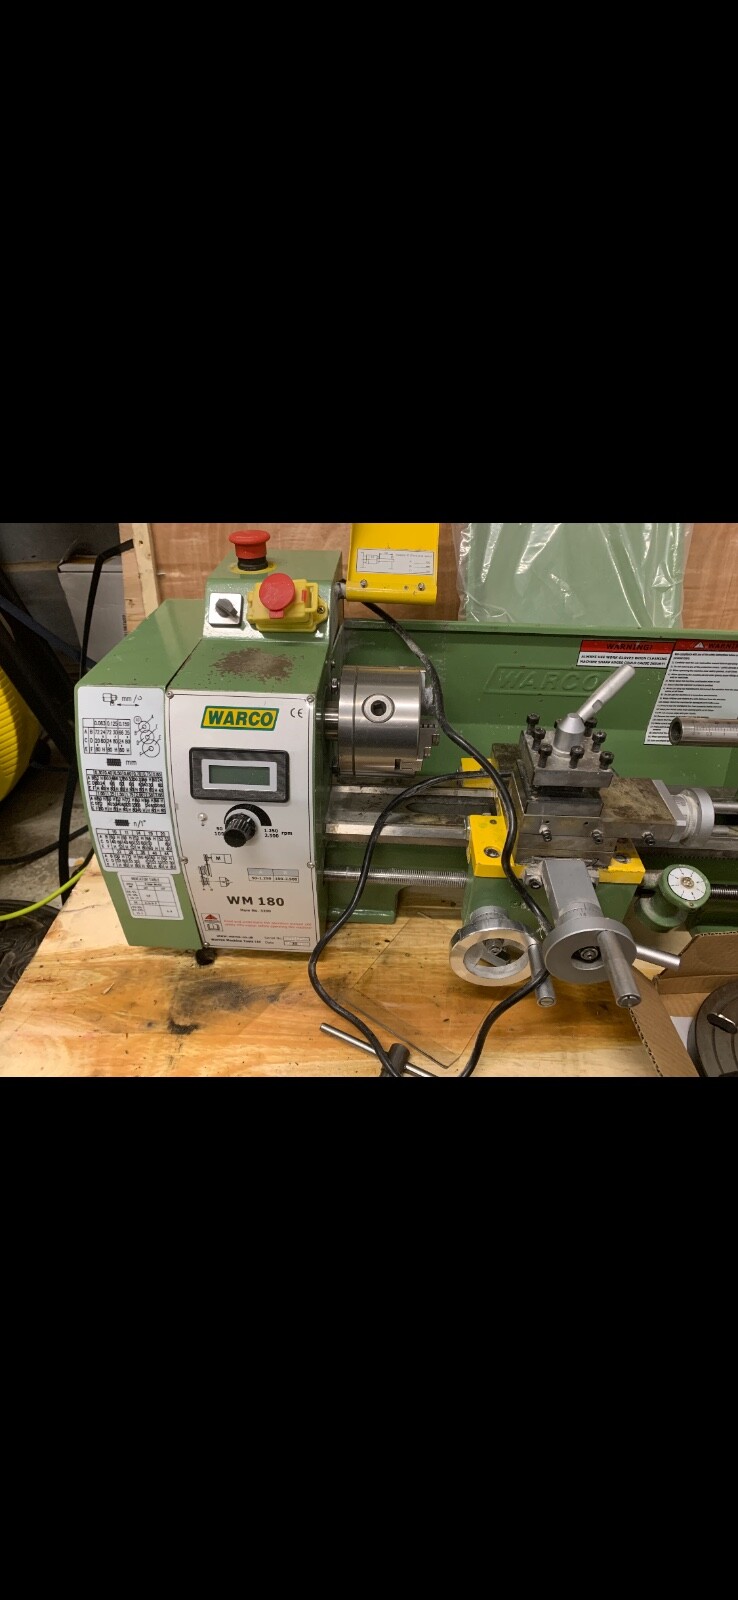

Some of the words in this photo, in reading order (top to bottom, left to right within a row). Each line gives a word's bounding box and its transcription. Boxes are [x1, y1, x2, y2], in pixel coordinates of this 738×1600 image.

[606, 643, 653, 651] WARNING!
[499, 669, 599, 692] WARCO
[208, 710, 273, 726] WARCO
[290, 707, 304, 718] CE
[226, 895, 253, 905] WM
[258, 896, 285, 907] 180
